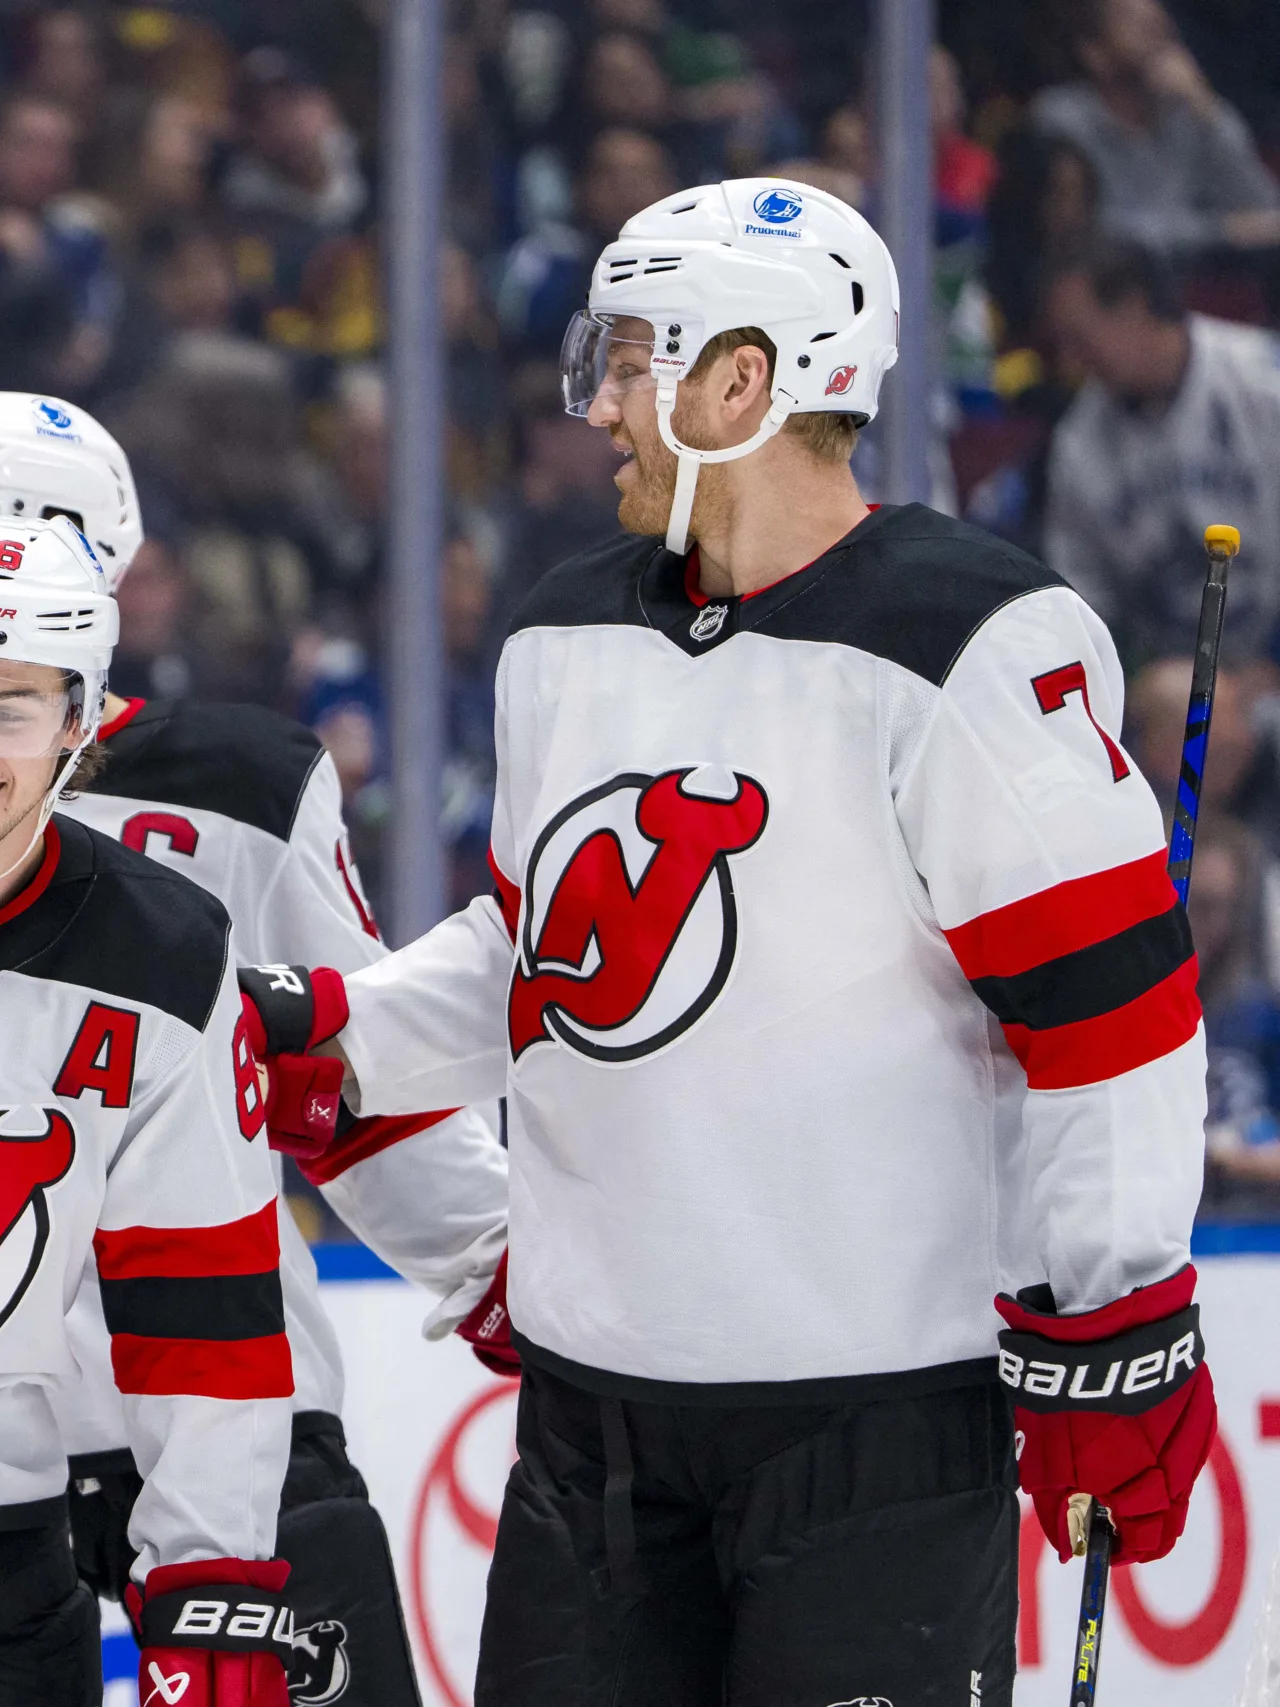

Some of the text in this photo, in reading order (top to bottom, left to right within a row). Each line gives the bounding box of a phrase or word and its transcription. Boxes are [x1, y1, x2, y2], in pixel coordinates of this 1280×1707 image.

[1030, 660, 1131, 784] 7
[53, 1000, 141, 1108] A
[1077, 1618, 1097, 1682] FLYLITE
